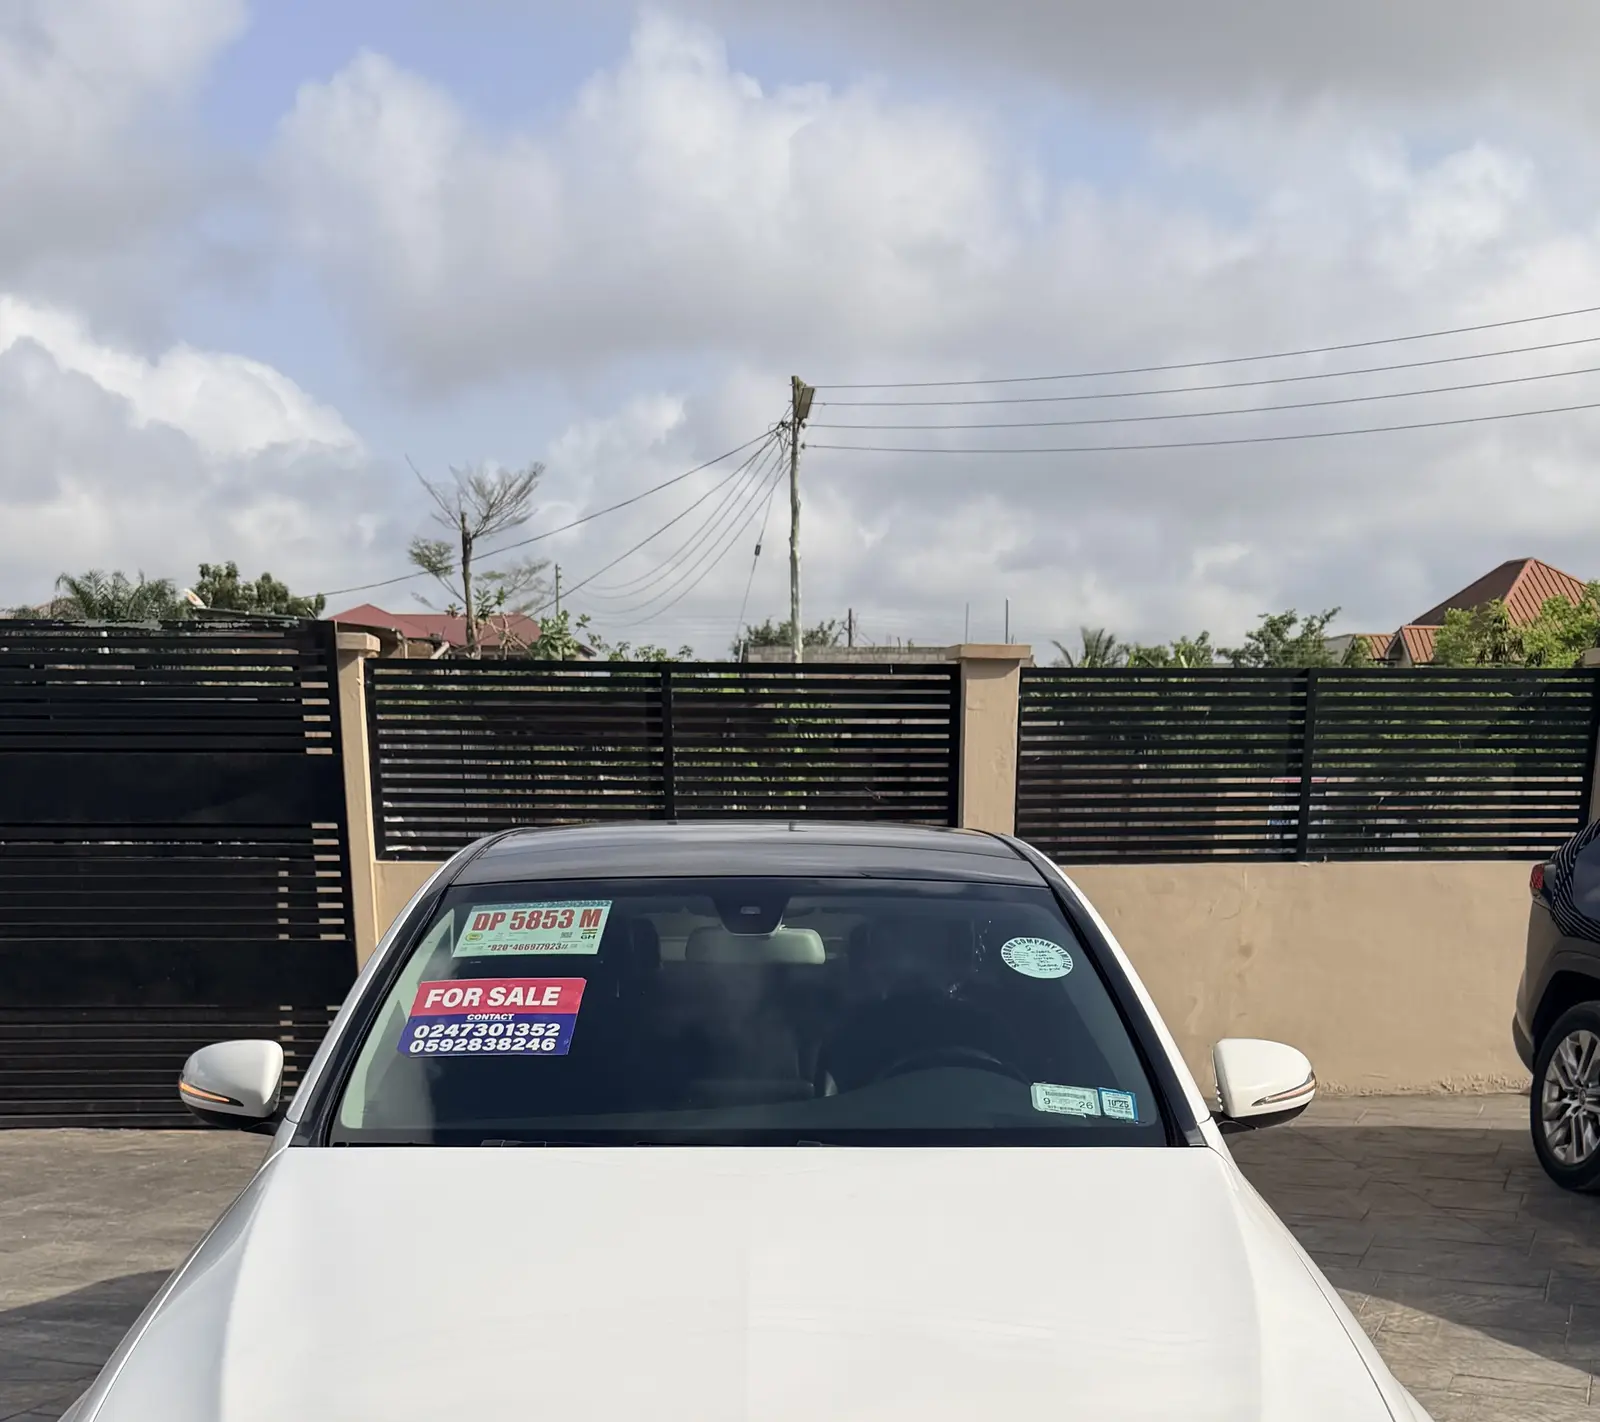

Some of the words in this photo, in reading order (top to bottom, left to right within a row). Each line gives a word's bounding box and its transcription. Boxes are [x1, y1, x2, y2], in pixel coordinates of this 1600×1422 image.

[472, 913, 507, 931] DP
[509, 909, 575, 931] 5853
[579, 908, 603, 928] M
[1014, 938, 1057, 950] COMPANY
[424, 988, 483, 1009] FOR
[487, 986, 562, 1007] SALE
[466, 1013, 515, 1021] CONTACT
[413, 1023, 561, 1038] 0247301352
[409, 1038, 557, 1053] 0592838246
[1079, 1101, 1094, 1109] 26
